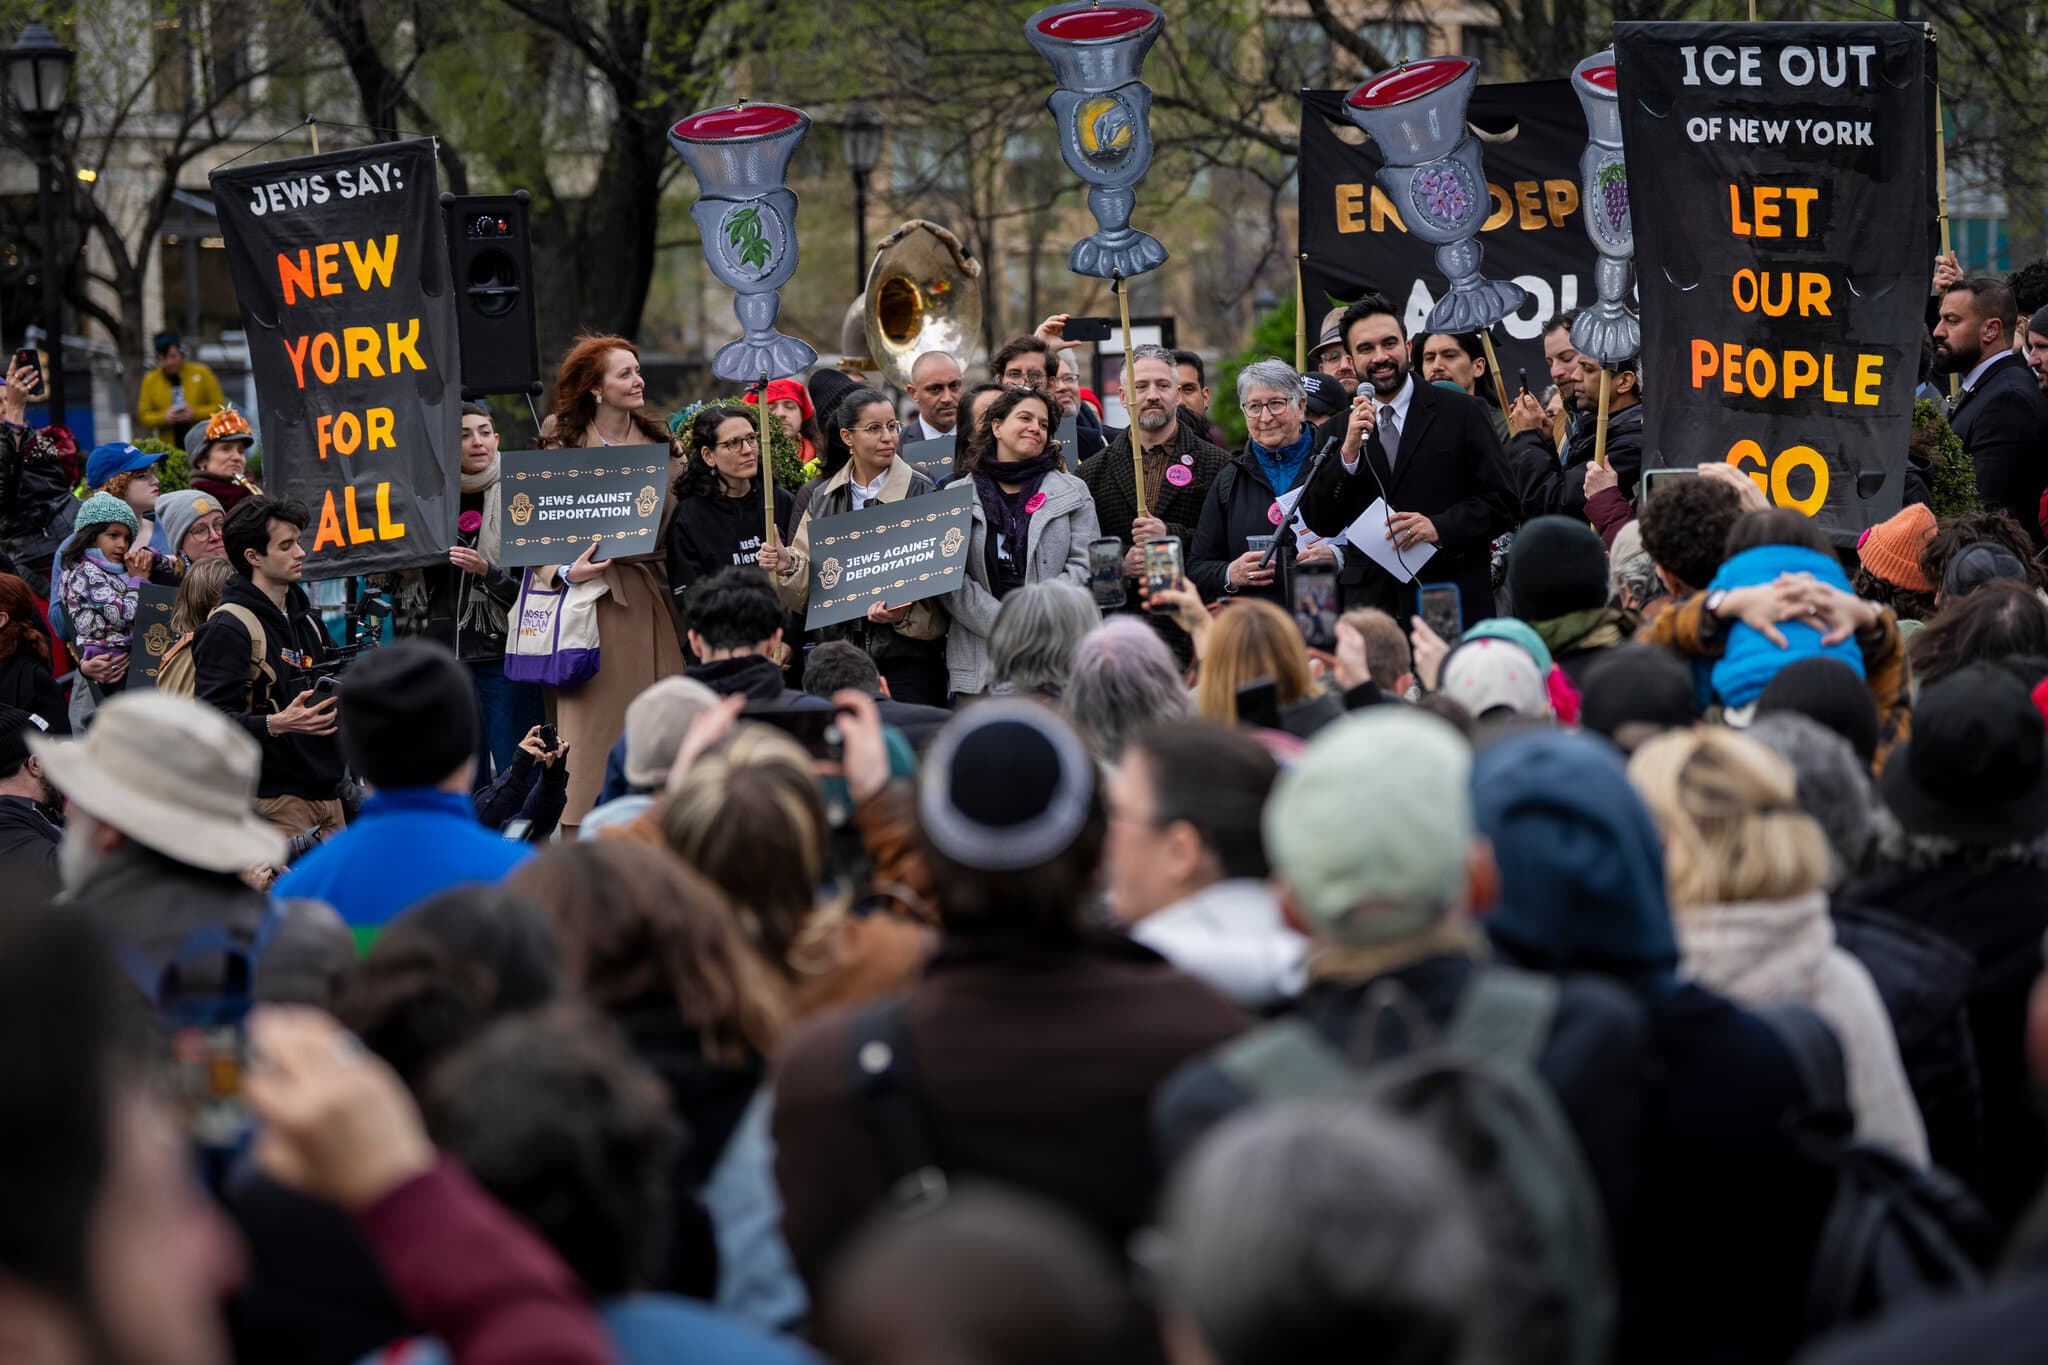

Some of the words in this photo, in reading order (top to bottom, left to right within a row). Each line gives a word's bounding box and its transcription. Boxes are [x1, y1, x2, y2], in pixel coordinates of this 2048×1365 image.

[1680, 45, 1762, 86] ICE
[1779, 45, 1876, 88] OUT
[1686, 117, 1722, 143] OF
[1729, 117, 1790, 144] NEW
[1795, 119, 1874, 146] YORK
[250, 174, 330, 216] JEWS
[336, 162, 403, 199] SAY:
[1335, 182, 1409, 233] EN
[1729, 184, 1819, 238] LET
[277, 234, 399, 306] NEW
[1732, 268, 1832, 317] OUR
[283, 318, 427, 389] YORK
[1691, 338, 1884, 406] PEOPLE
[316, 407, 397, 460] FOR
[538, 494, 574, 507] JEWS
[577, 492, 633, 505] AGAINST
[1725, 439, 1830, 518] GO
[312, 481, 405, 552] ALL
[538, 506, 631, 521] DEPORTATION
[845, 550, 935, 582] DEPORTATION
[846, 551, 881, 568] JEWS
[883, 537, 937, 559] AGAINST
